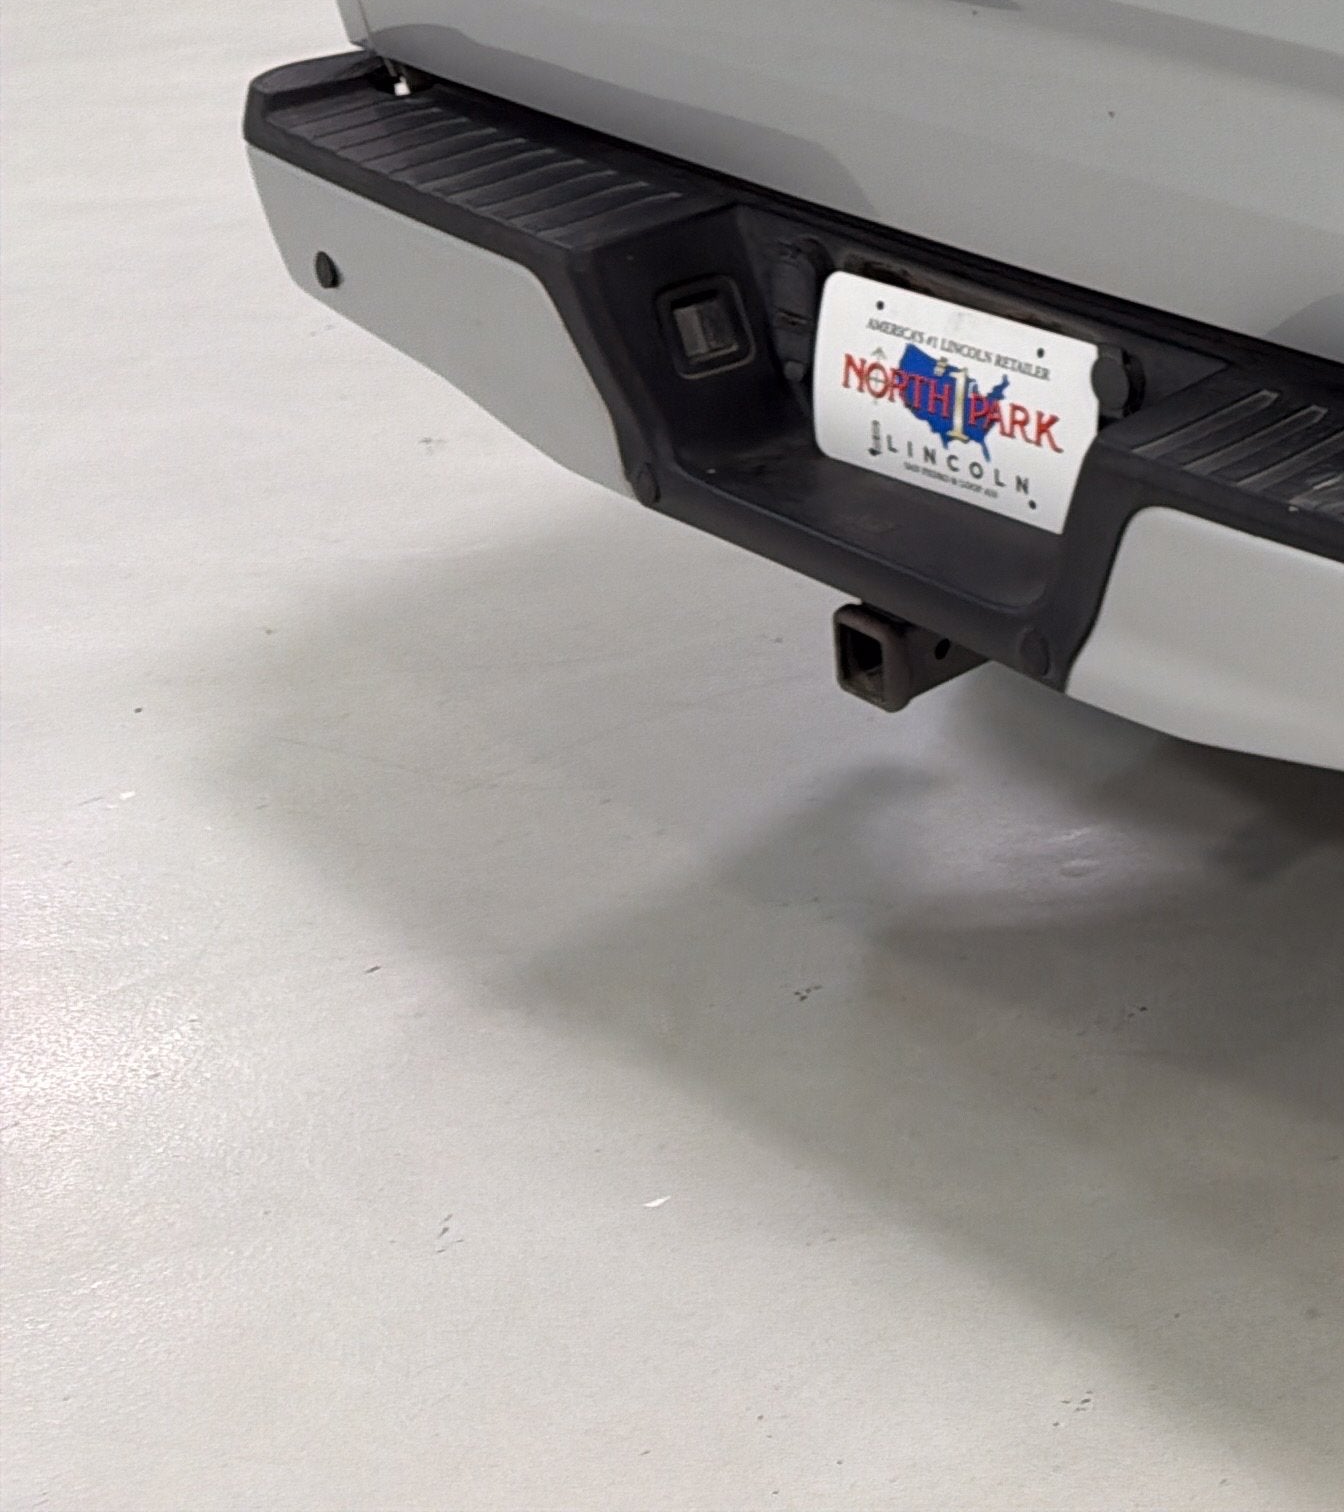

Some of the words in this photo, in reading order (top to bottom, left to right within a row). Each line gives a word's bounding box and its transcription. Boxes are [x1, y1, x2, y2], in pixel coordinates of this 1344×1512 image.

[940, 338, 993, 364] LINCOLN
[993, 353, 1052, 382] RETAILER
[841, 352, 952, 420] NORTH
[967, 392, 1066, 454] PARK
[887, 434, 1031, 497] LINCOLN
